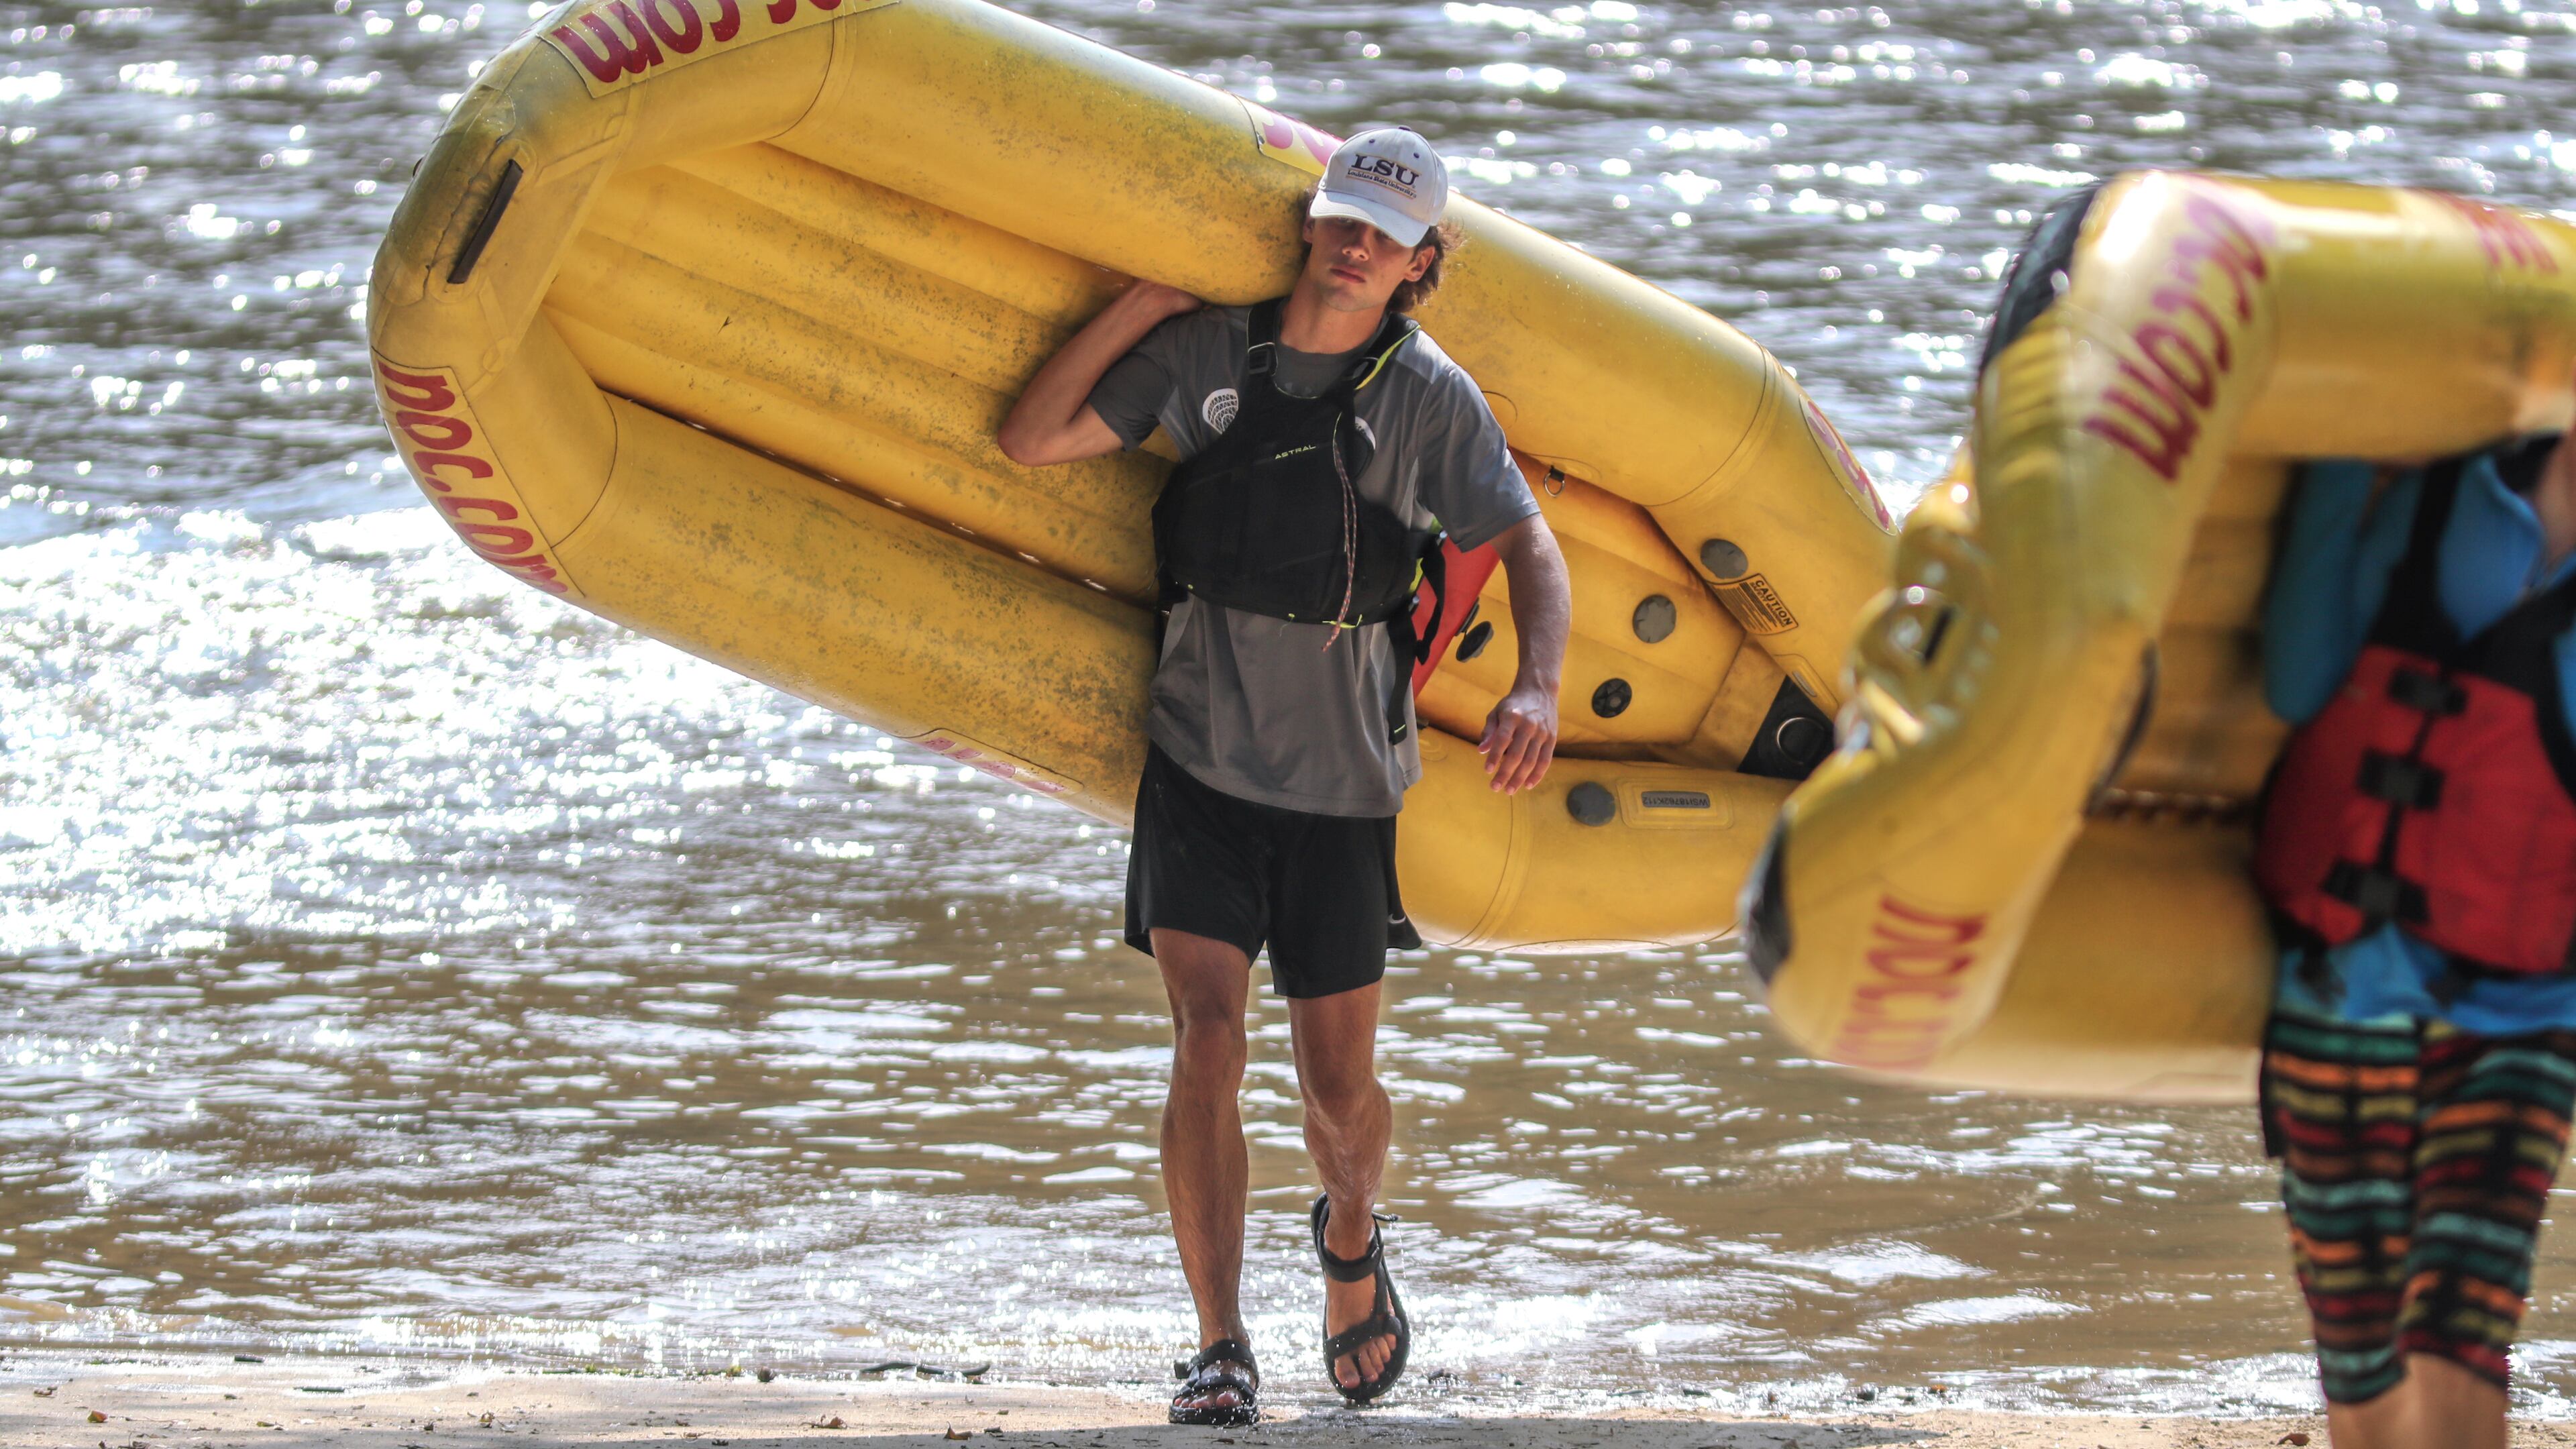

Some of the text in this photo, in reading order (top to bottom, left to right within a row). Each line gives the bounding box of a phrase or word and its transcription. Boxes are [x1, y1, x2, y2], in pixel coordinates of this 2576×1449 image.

[1351, 154, 1419, 185] LSU
[2082, 190, 2275, 483] oc.com
[1275, 445, 1316, 460] ASTRAL
[1755, 580, 1793, 625] CAUTION
